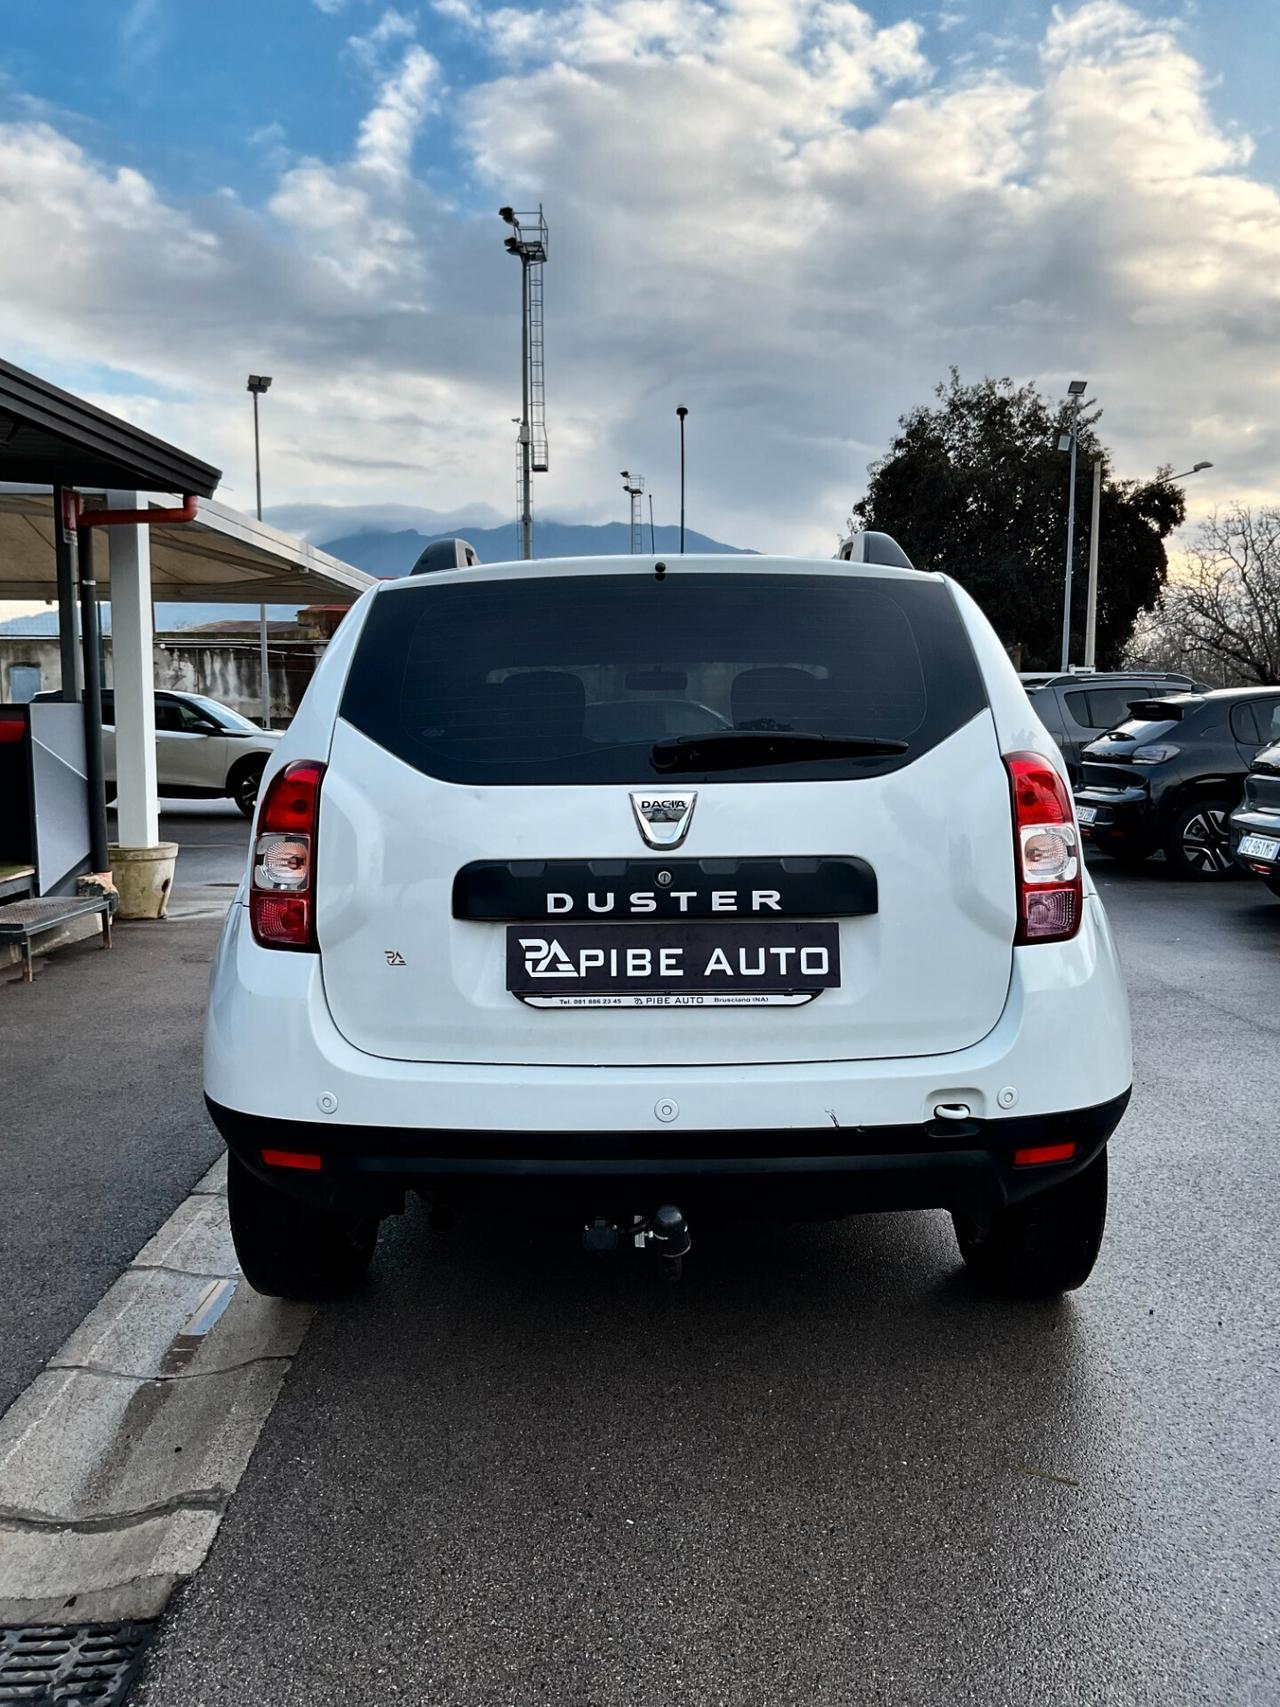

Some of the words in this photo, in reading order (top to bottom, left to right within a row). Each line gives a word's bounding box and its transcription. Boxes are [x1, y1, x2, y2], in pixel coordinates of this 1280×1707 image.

[641, 800, 687, 809] DACIA
[546, 890, 782, 914] DUSTER
[579, 948, 684, 977] PIBE
[704, 947, 829, 976] AUTO
[646, 997, 671, 1005] PIBE
[674, 996, 704, 1004] AUTO
